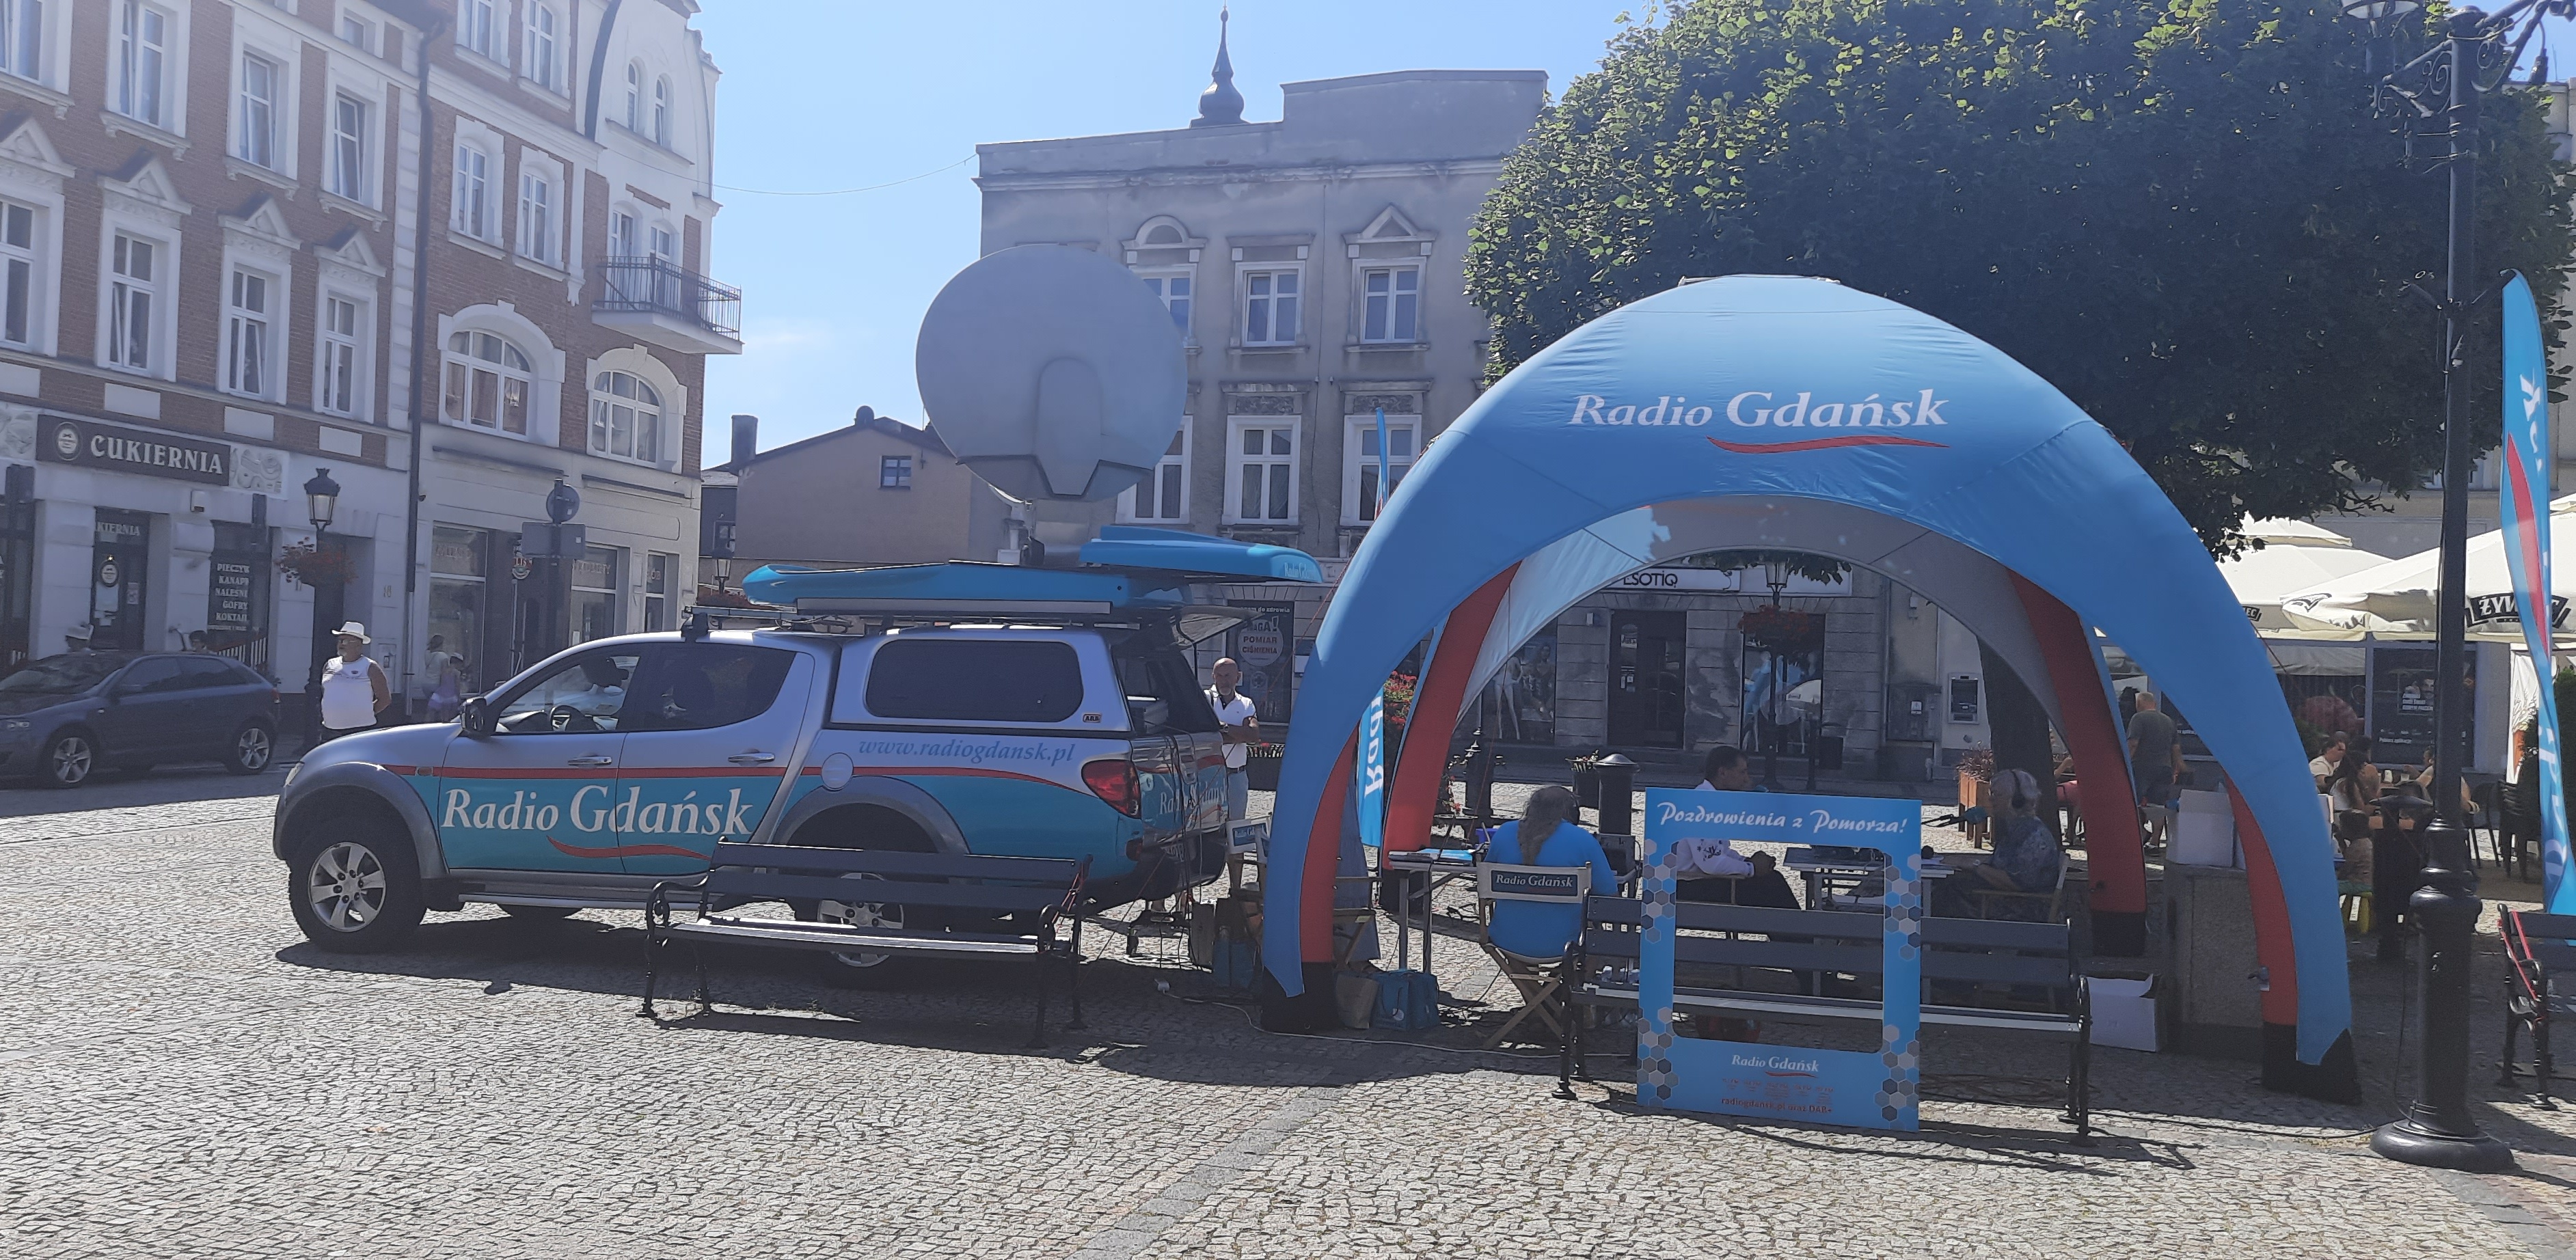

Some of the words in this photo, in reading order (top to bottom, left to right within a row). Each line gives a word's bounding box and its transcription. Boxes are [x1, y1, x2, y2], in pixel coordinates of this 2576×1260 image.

[1569, 394, 1712, 426] Radio
[1726, 389, 1949, 427] Gdańsk
[90, 435, 223, 474] CUKIERNIA
[1623, 570, 1678, 588] ESOTIQ
[1243, 635, 1277, 644] POMIAR
[859, 739, 1076, 767] www.radiogdansk.pl
[441, 789, 558, 831] Radio
[570, 784, 753, 835] Gdańsk
[1657, 801, 1785, 827] Pozdrowienia
[1792, 815, 1804, 828] z
[1809, 809, 1908, 834] Pomorza!
[1496, 874, 1526, 886] Radio
[1528, 875, 1573, 888] Gdańsk
[1731, 1054, 1766, 1068] Radio
[1768, 1056, 1819, 1073] Gdańsk
